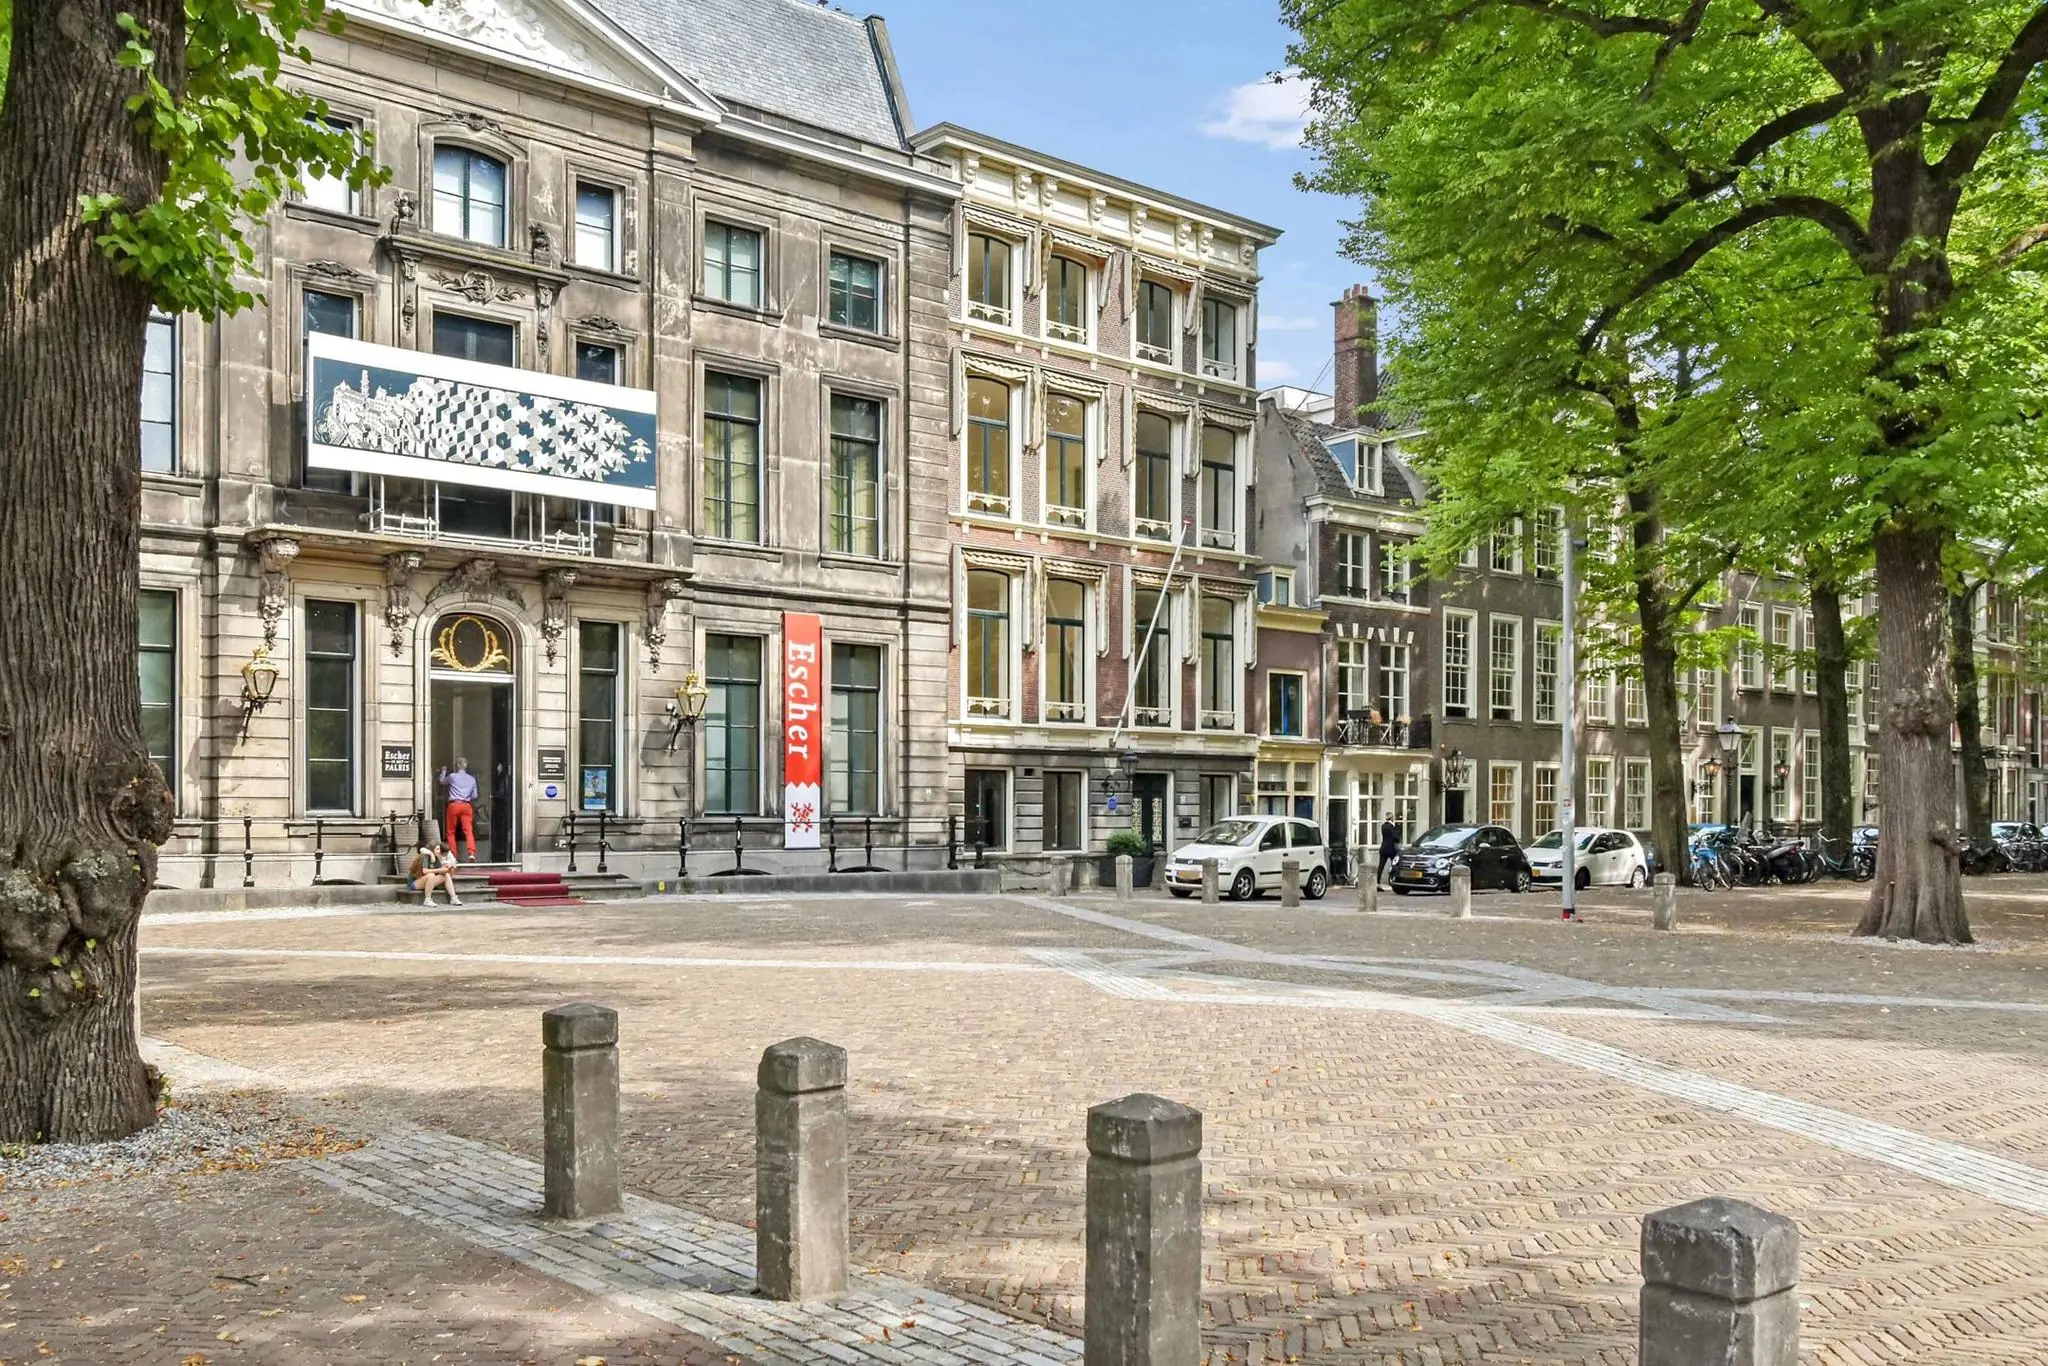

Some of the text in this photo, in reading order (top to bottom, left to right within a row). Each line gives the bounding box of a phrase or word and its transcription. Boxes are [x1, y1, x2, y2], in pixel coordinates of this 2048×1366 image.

[788, 640, 817, 760] Escher
[384, 750, 410, 760] Escher
[384, 763, 410, 771] PALEIS
